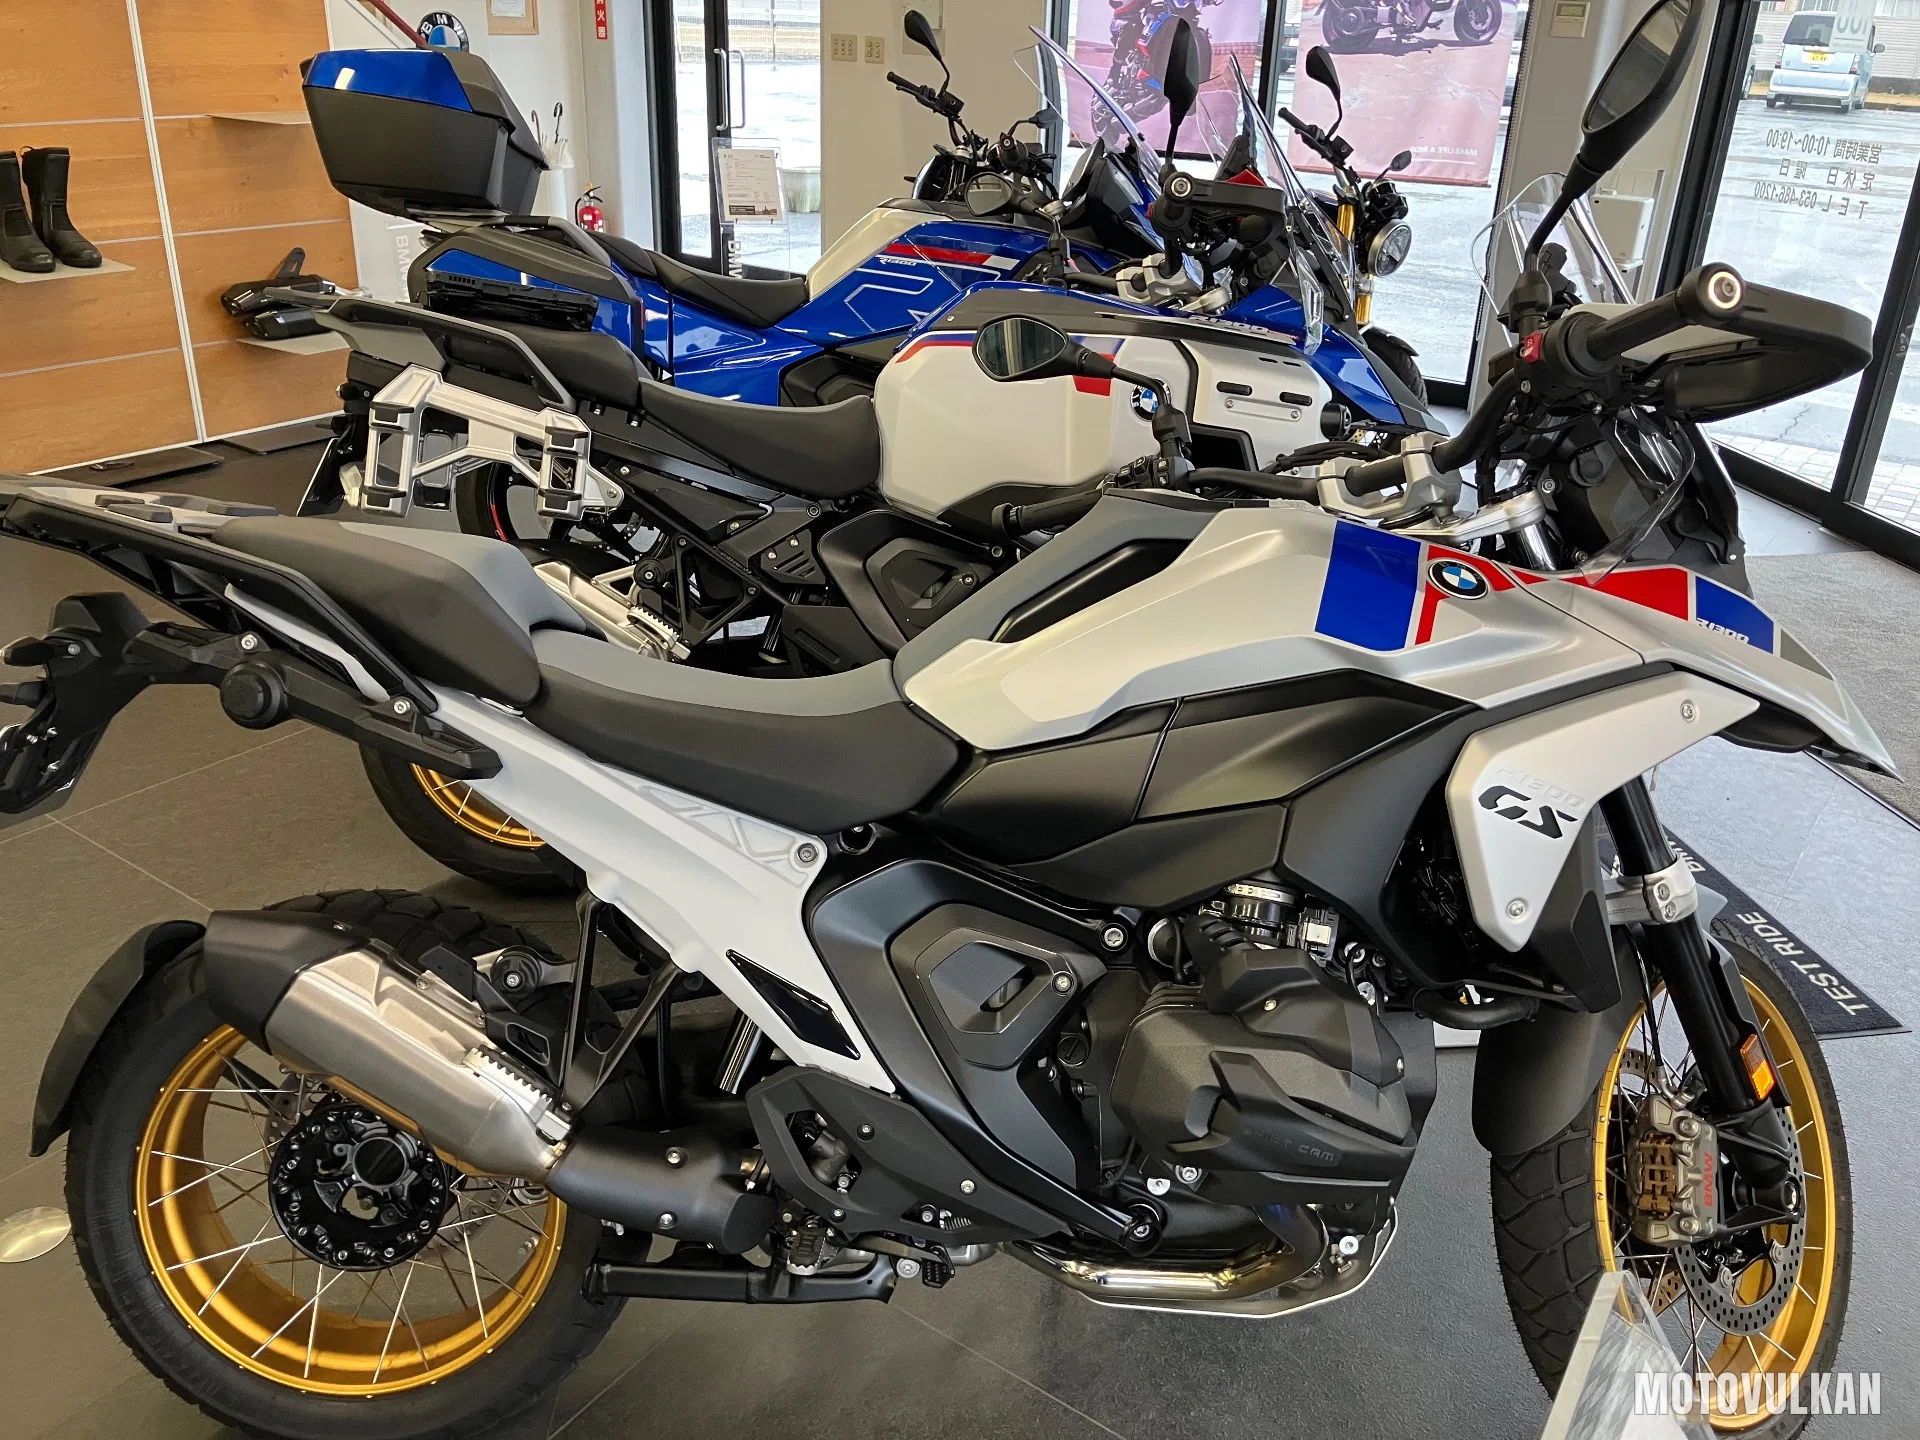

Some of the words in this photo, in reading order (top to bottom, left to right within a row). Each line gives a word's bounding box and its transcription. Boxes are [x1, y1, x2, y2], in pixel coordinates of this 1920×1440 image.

[1736, 911, 1804, 956] RIDE
[1790, 959, 1869, 1015] TEST
[1703, 1151, 1713, 1208] BMW
